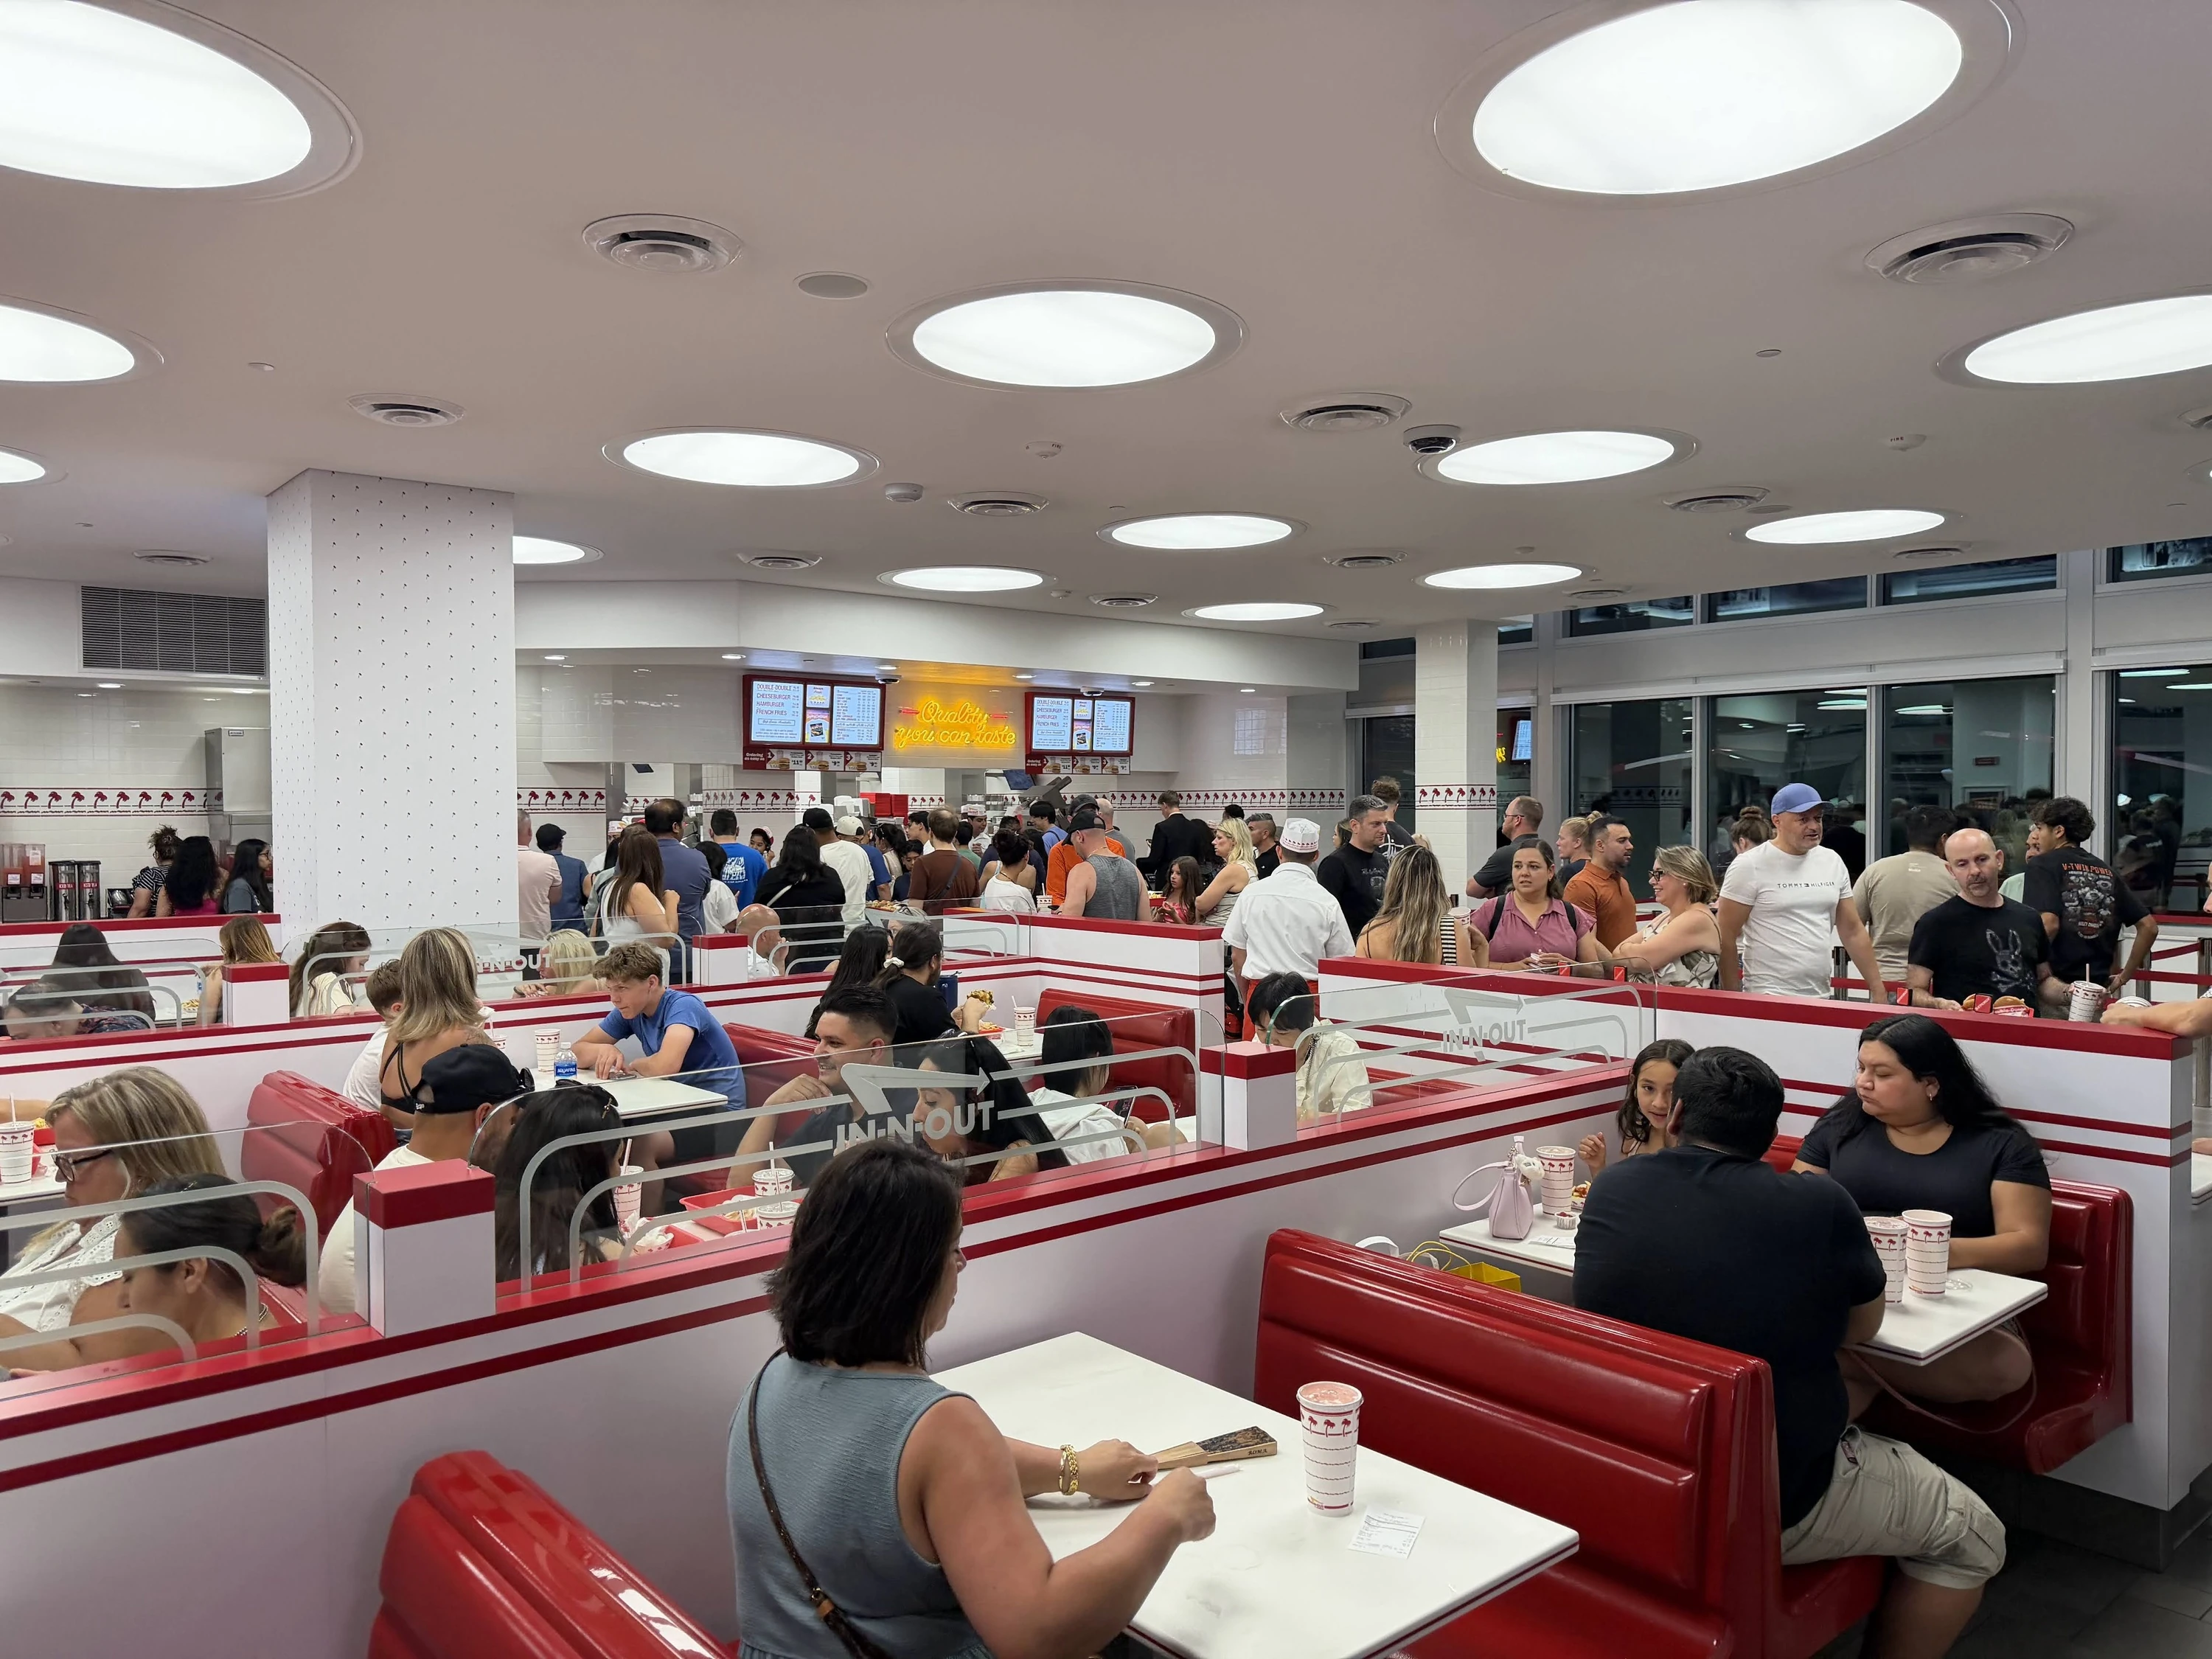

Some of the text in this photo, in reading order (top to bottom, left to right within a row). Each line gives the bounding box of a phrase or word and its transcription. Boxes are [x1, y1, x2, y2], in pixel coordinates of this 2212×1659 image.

[922, 700, 989, 731] Quality
[896, 727, 935, 748] you
[939, 730, 971, 744] can
[975, 726, 1016, 745] taste
[2062, 863, 2113, 877] V-TWIN POWER
[1442, 1019, 1526, 1053] IN-N-OUT
